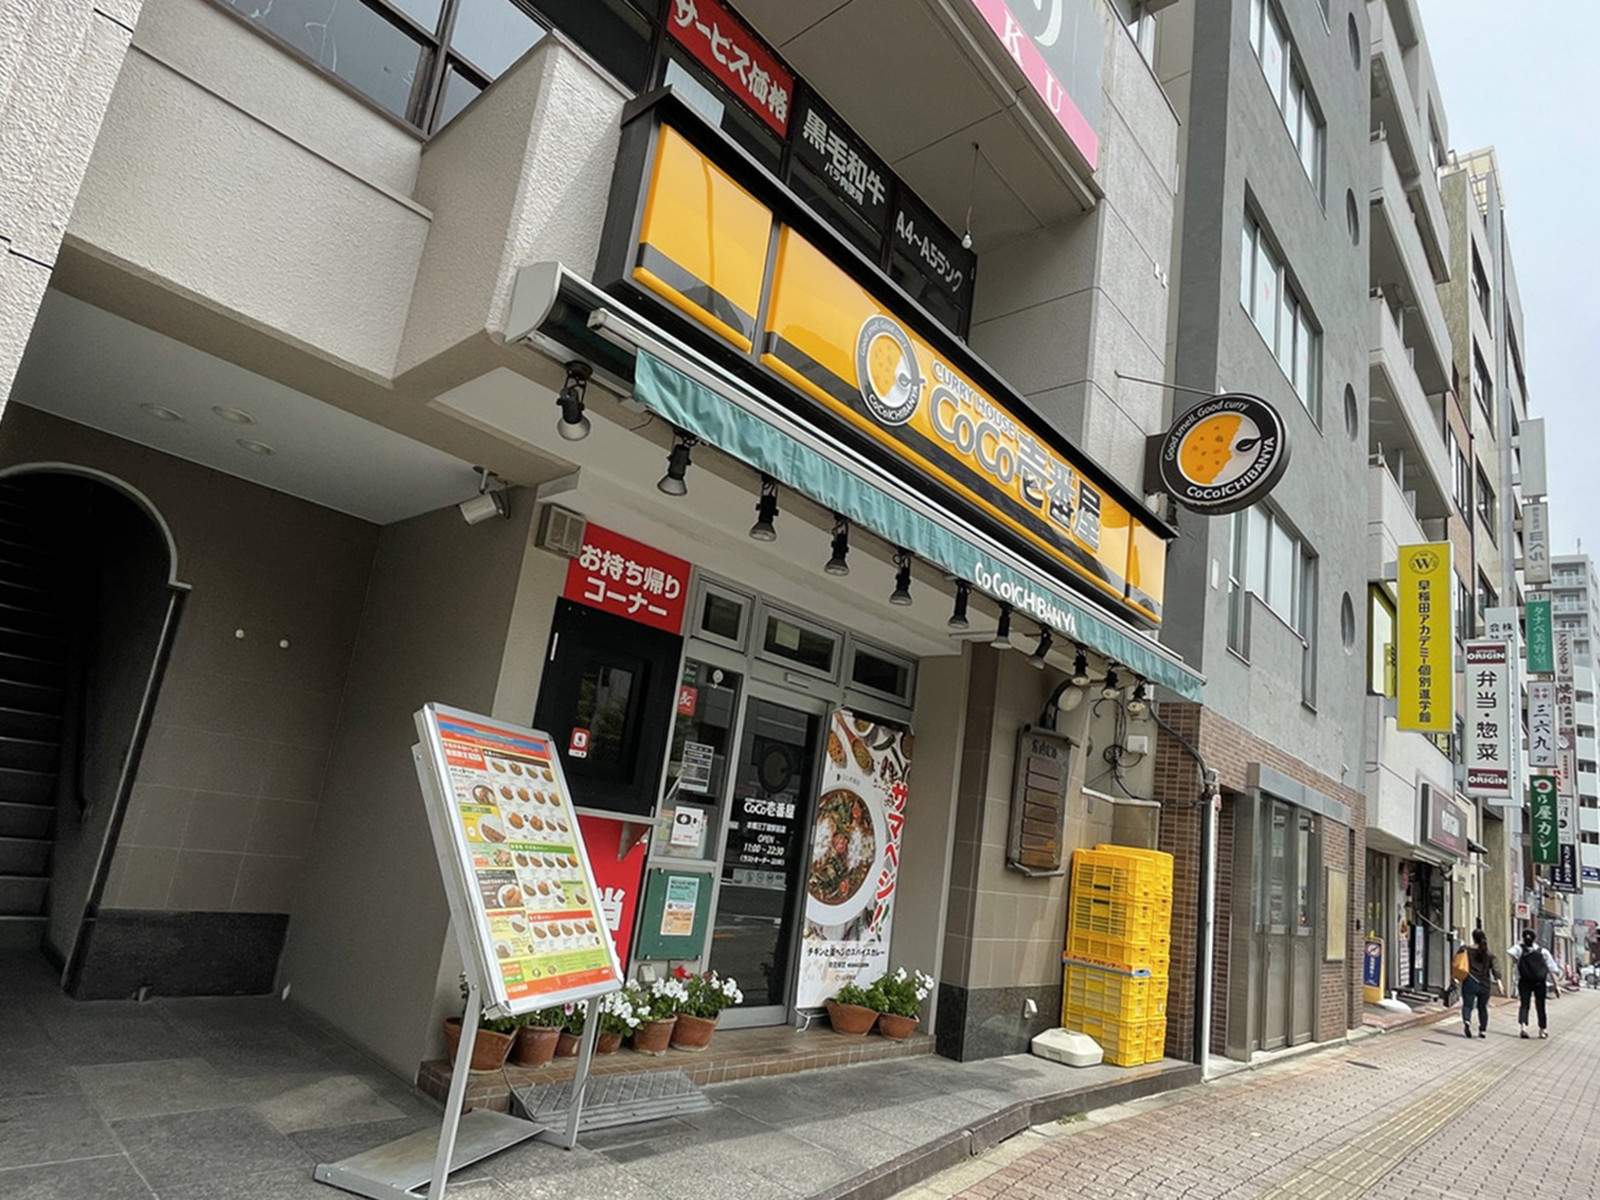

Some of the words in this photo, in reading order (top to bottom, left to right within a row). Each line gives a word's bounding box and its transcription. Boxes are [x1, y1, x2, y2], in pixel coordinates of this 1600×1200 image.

[674, 0, 788, 123] サービス価格
[803, 108, 886, 206] 黒毛和牛
[933, 361, 974, 403] CURRY
[976, 395, 1017, 440] HOUSE
[1165, 437, 1180, 461] Good
[1197, 400, 1223, 417] Good
[1224, 401, 1250, 411] curry
[1186, 437, 1275, 499] CoCoICHIBANYA
[578, 544, 681, 599] お持ち帰り
[584, 576, 667, 617] コーナー
[1417, 579, 1432, 723] 早稲田アカデミー個別進学館
[1467, 652, 1505, 661] ORIGIN
[1476, 670, 1498, 761] 弁当・惣菜
[1468, 777, 1507, 785] ORIGIN
